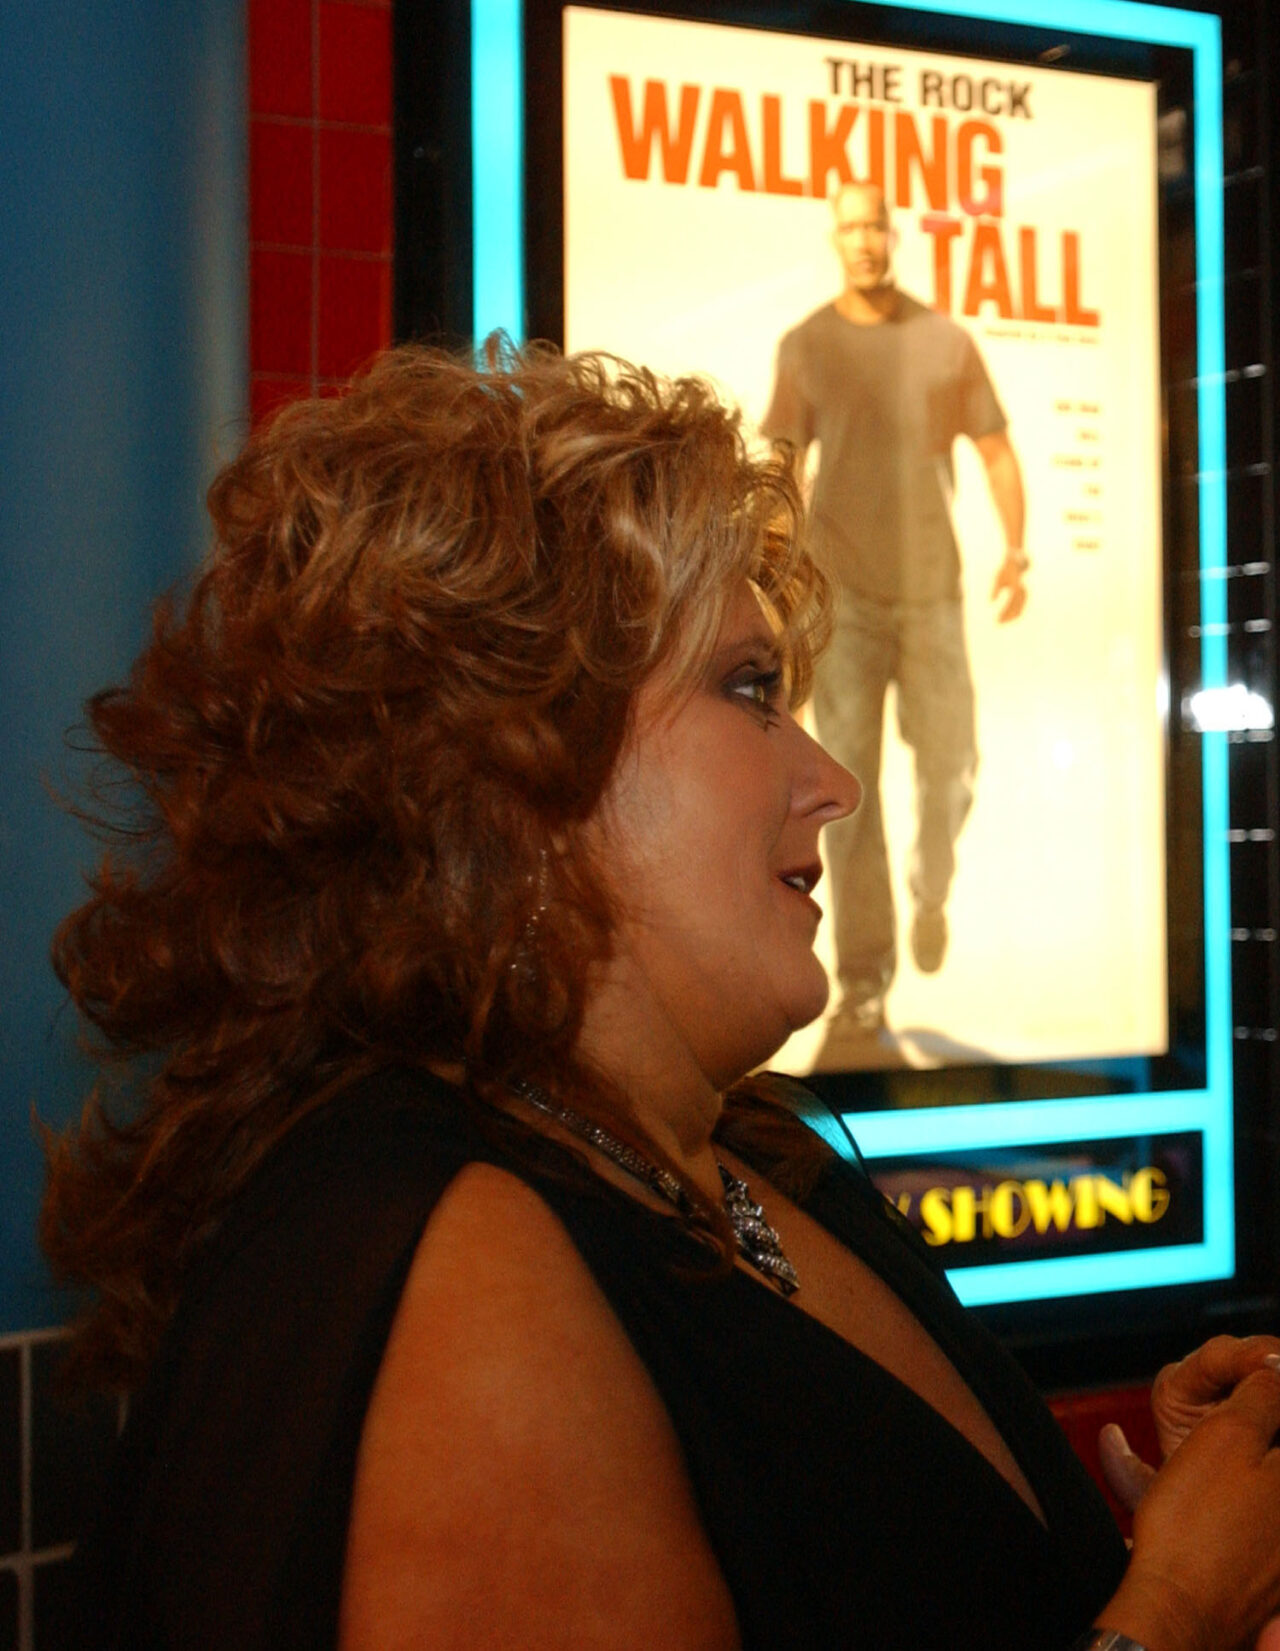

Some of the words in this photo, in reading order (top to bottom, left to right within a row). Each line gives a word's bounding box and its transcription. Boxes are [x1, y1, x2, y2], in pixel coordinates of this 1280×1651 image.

[825, 56, 902, 104] THE
[920, 68, 1035, 120] ROCK
[608, 73, 1004, 219] WALKING
[921, 213, 1100, 329] TALL
[920, 1166, 1171, 1247] SHOWING
